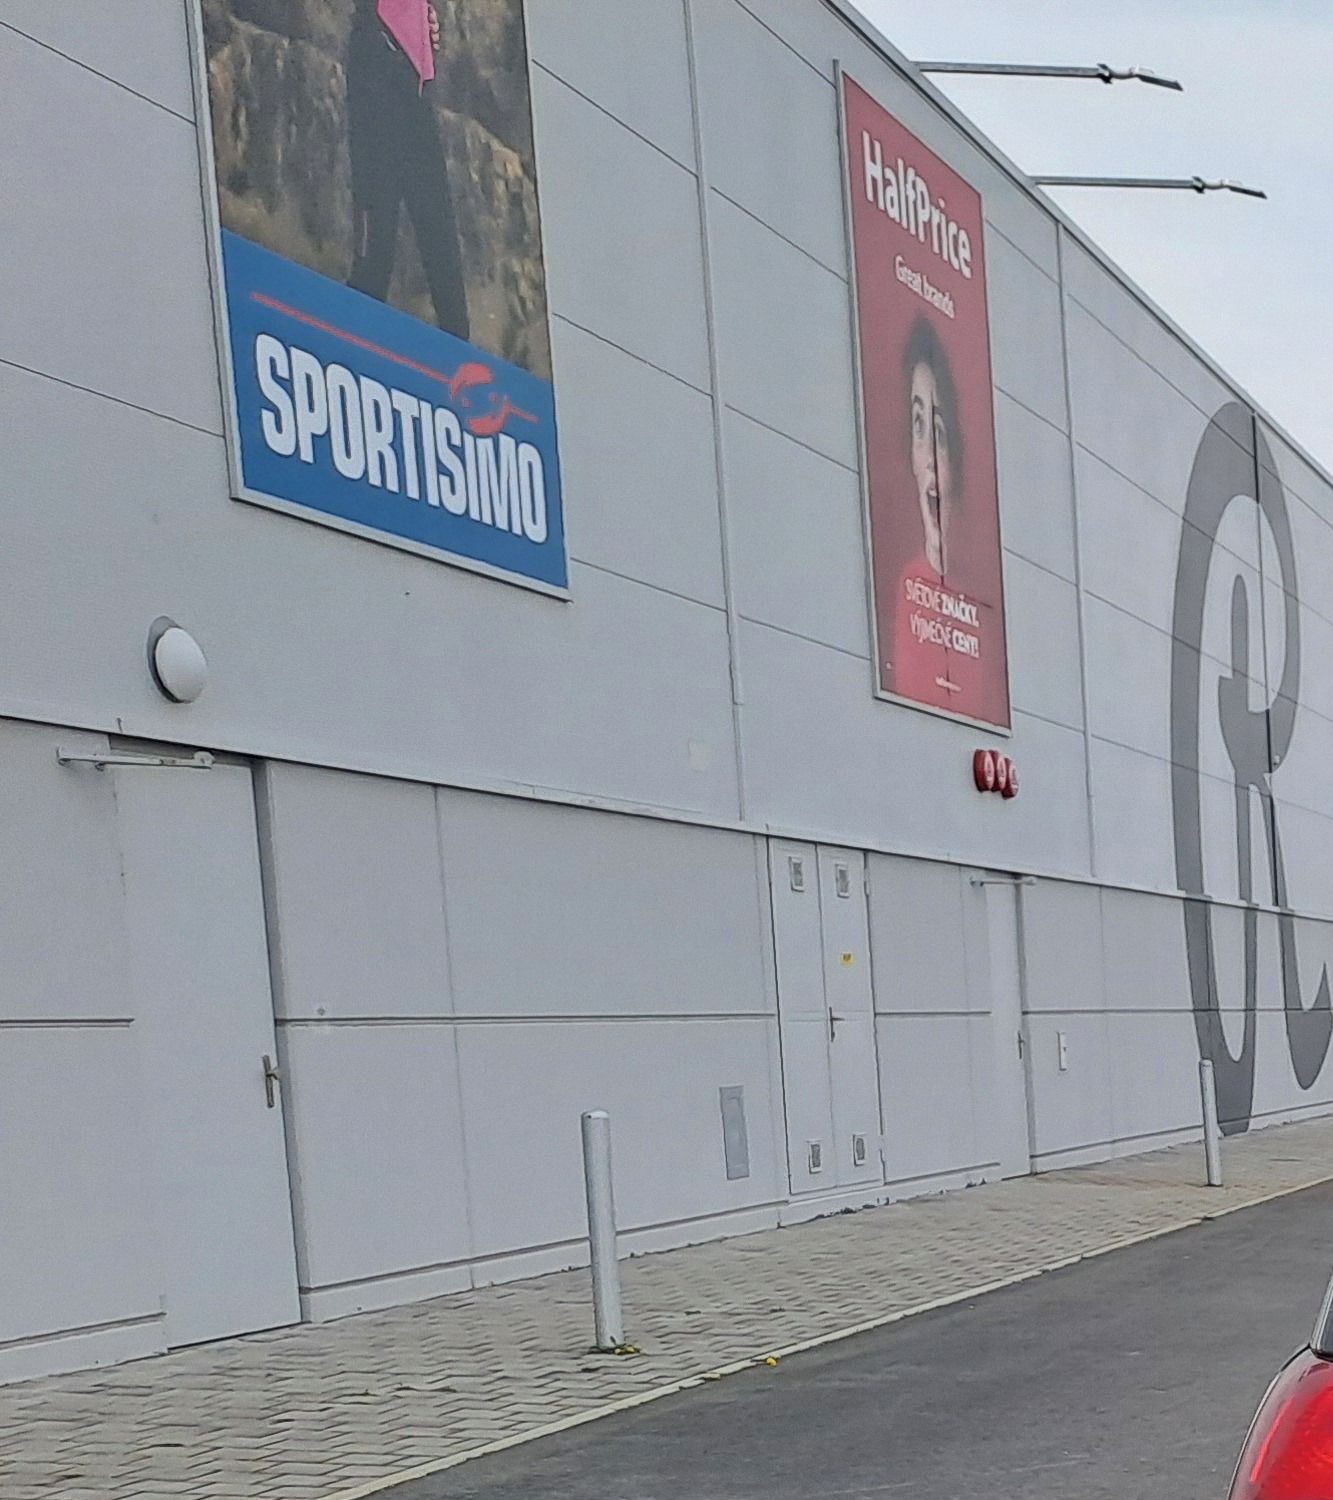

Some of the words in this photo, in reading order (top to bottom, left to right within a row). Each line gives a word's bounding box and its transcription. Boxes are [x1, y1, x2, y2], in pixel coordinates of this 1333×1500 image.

[863, 130, 973, 279] HalfPrice
[895, 255, 922, 297] Great
[922, 274, 955, 319] brands
[256, 333, 548, 544] SPORTISIMO
